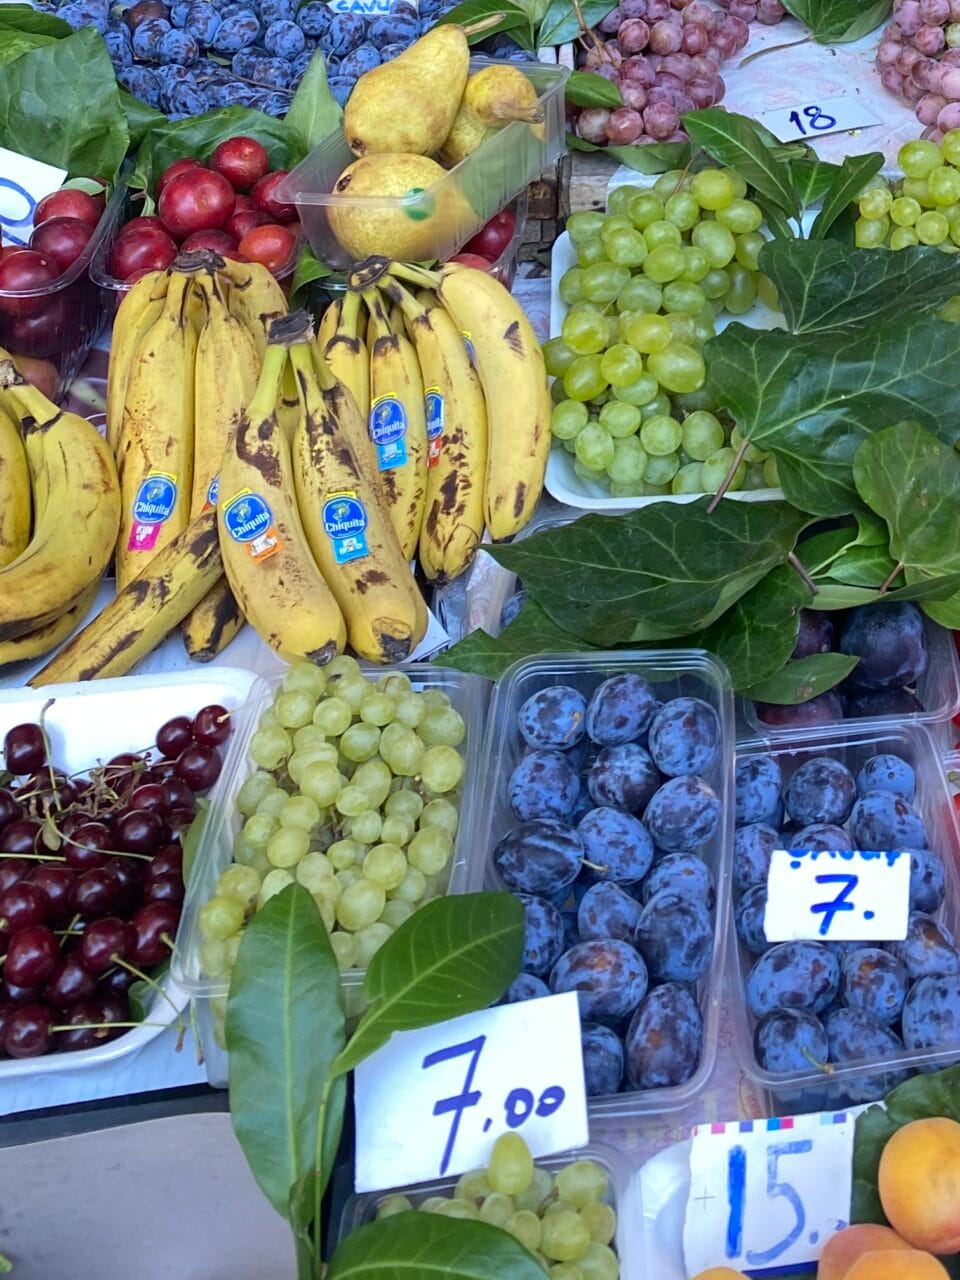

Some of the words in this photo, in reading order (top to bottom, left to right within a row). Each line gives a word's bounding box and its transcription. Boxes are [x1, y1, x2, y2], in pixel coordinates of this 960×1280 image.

[789, 105, 837, 135] 18
[373, 420, 406, 438] Chiquita
[134, 501, 171, 516] Chiquita
[231, 511, 271, 538] Chiquita
[325, 518, 366, 533] Chiquita
[421, 1033, 566, 1176] 7,00
